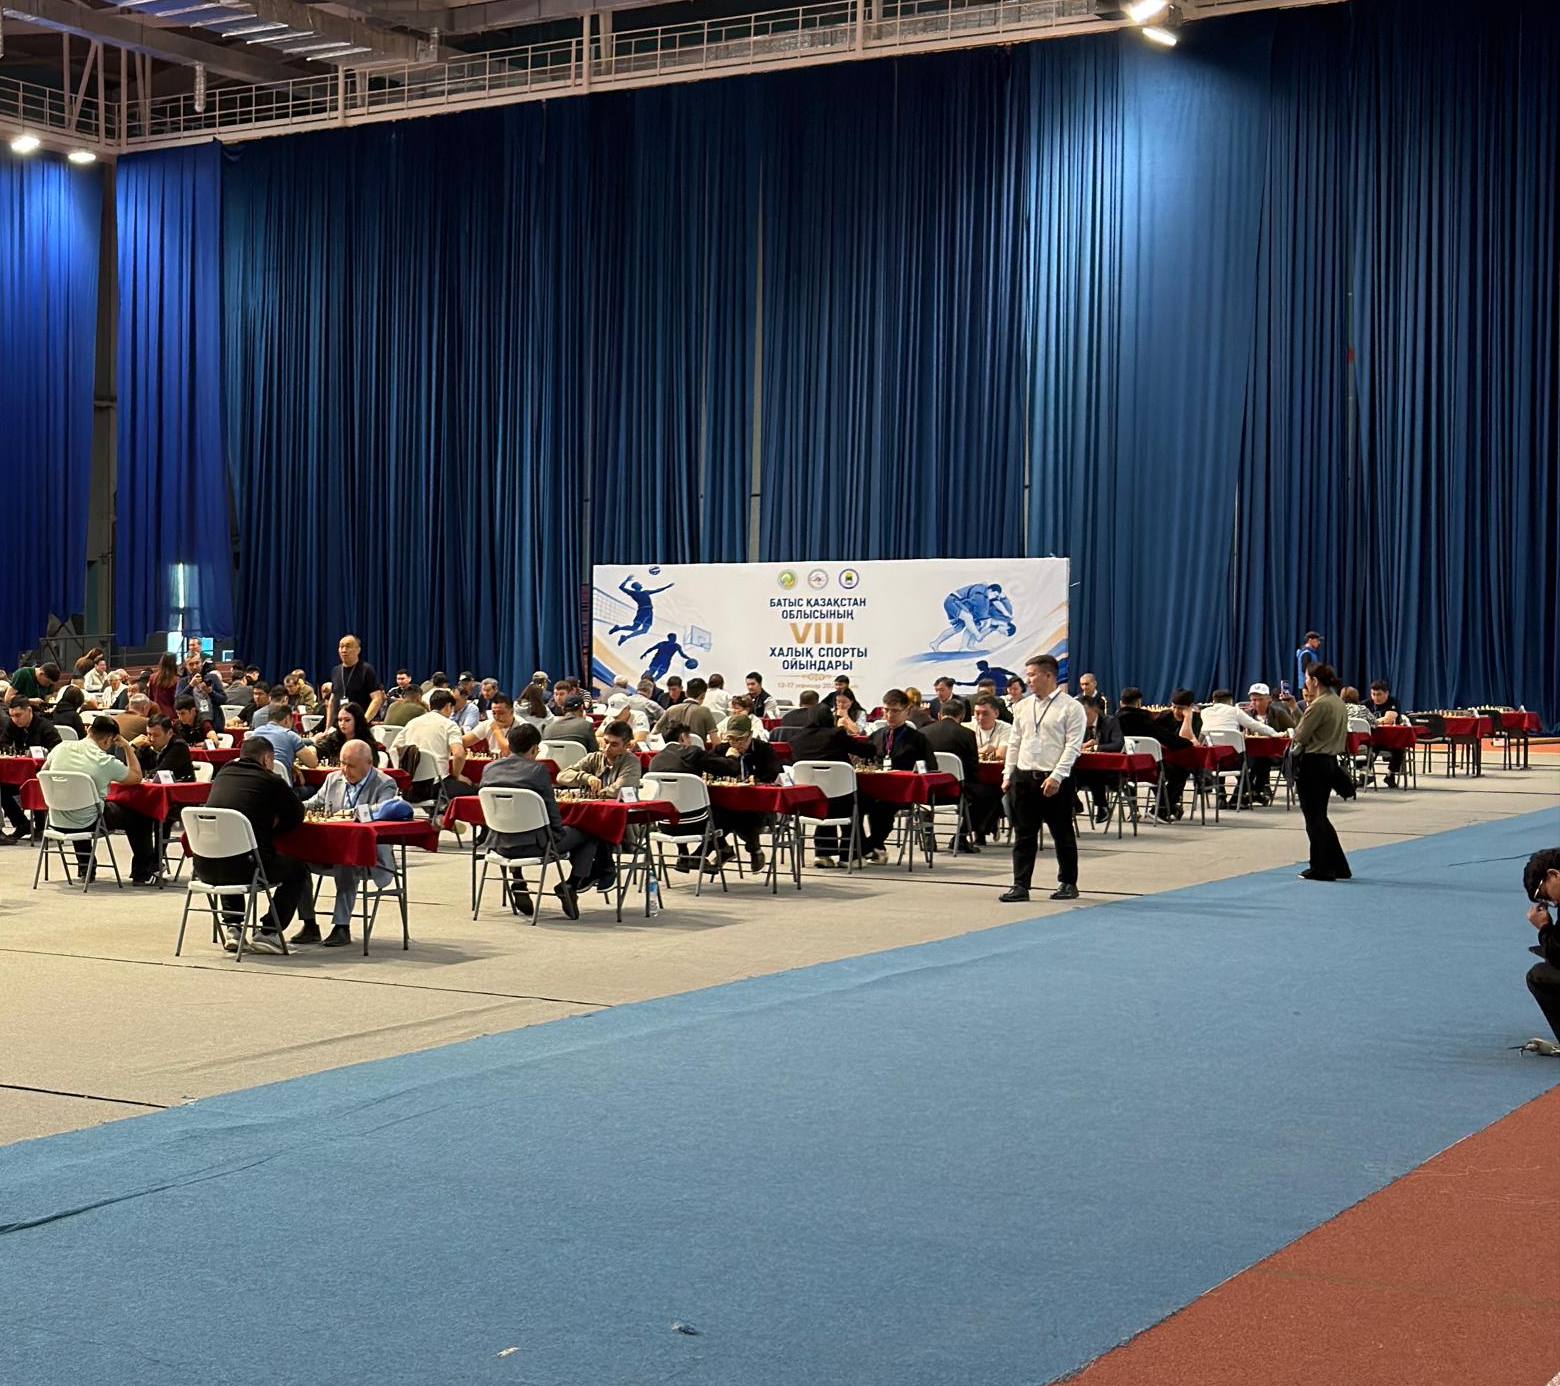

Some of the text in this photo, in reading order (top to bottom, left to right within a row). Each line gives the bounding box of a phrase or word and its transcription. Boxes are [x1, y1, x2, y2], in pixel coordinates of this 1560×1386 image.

[769, 598, 866, 608] БАТЫС ҚАЗАҚСТАН
[781, 609, 854, 620] ОБЛЫСЫНЫҢ
[790, 622, 844, 644] VIII
[769, 647, 867, 659] ХАЛЫҚ СПОРТЫ
[782, 658, 853, 671] ОЙЫНДАРЫ
